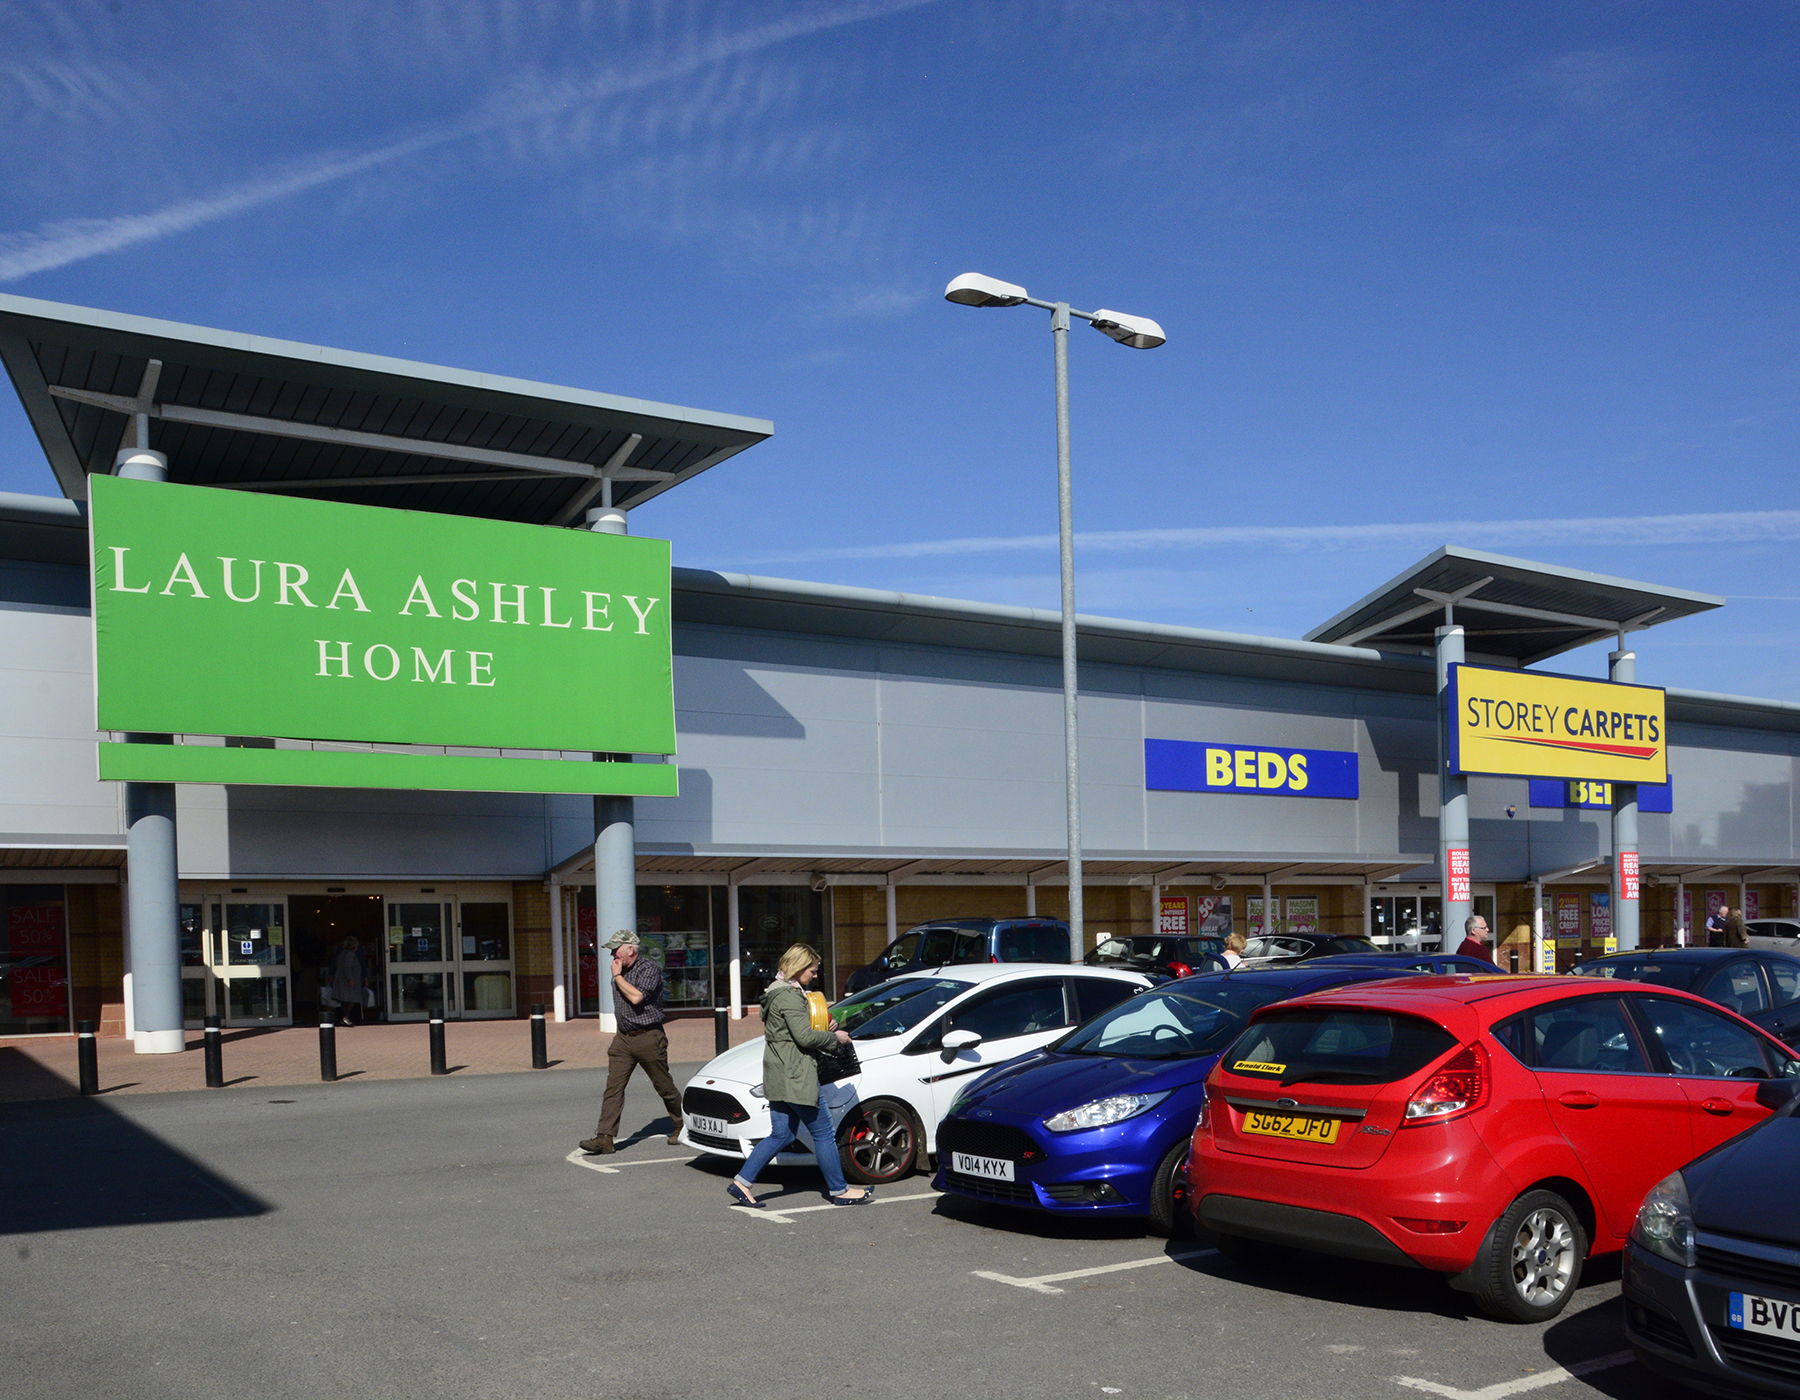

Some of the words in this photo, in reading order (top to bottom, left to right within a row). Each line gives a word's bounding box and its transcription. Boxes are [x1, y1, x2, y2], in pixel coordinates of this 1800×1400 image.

[108, 546, 371, 613] LAURA
[399, 574, 661, 636] ASHLEY
[315, 639, 497, 688] HOME
[1467, 697, 1560, 735] STOREY
[1564, 706, 1660, 743] CARPETS
[1205, 748, 1308, 792] BEDS
[1570, 781, 1612, 805] BE
[1559, 898, 1565, 908] 2
[12, 908, 57, 924] SALE
[1559, 910, 1578, 920] FREE
[1559, 921, 1578, 929] CREDIT
[20, 929, 54, 944] 50%
[14, 969, 57, 984] SALE
[23, 989, 56, 1004] 50%
[1235, 1062, 1261, 1070] Arnold
[1260, 1064, 1282, 1072] Clark
[693, 1115, 707, 1131] NU13
[708, 1119, 723, 1133] XAJ
[1251, 1113, 1294, 1133] SG62
[1297, 1119, 1333, 1138] JFO
[958, 1154, 981, 1172] VO14
[983, 1158, 1007, 1177] KYX
[1731, 1313, 1742, 1323] GB
